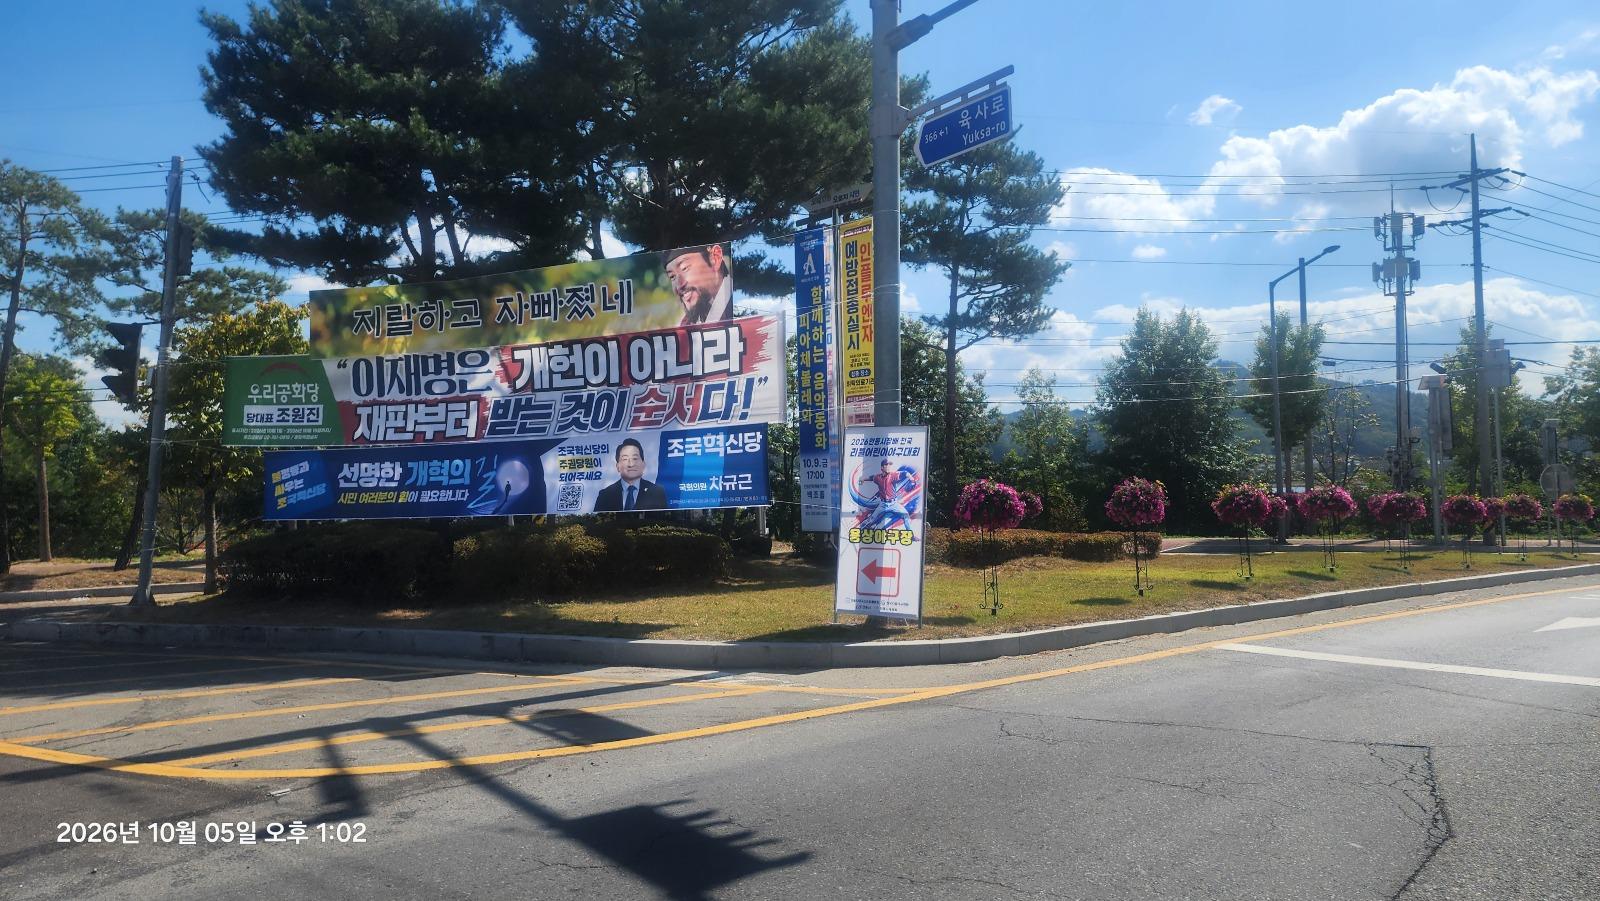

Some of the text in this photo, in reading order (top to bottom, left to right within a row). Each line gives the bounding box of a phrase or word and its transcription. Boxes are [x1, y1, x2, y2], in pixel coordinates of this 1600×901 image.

[959, 95, 1005, 129] 육사로
[962, 121, 1006, 145] Yuksa-ro
[846, 240, 860, 350] 예방접종실시
[860, 242, 874, 343] 인플루엔자
[353, 279, 633, 338] 지랄하고 자빠졌네
[512, 339, 621, 391] 개헌이
[628, 326, 747, 382] 아니라
[800, 312, 812, 424] 피아체볼레와
[811, 285, 827, 449] 함께하는 음악동화
[248, 382, 319, 404] 우리공화당
[246, 406, 320, 424] 당대표 조원진
[353, 400, 478, 441] 재판부터
[485, 394, 554, 438] 받는
[554, 387, 630, 434] 것이
[558, 443, 609, 457] 조국혁신당의
[667, 431, 763, 458] 조국혁신당
[900, 437, 913, 445] 전국
[337, 462, 403, 488] 선명한
[405, 459, 472, 487] 개혁의
[559, 457, 602, 470] 주권당원이
[559, 470, 602, 482] 되어주세요
[806, 470, 825, 480] 17:00
[679, 473, 753, 492] 국회의원 차규근
[277, 483, 327, 510] 조국혁신당
[337, 489, 470, 505] 시민 여러분의 힘이 필요합니다
[849, 528, 913, 546] 용상야구장
